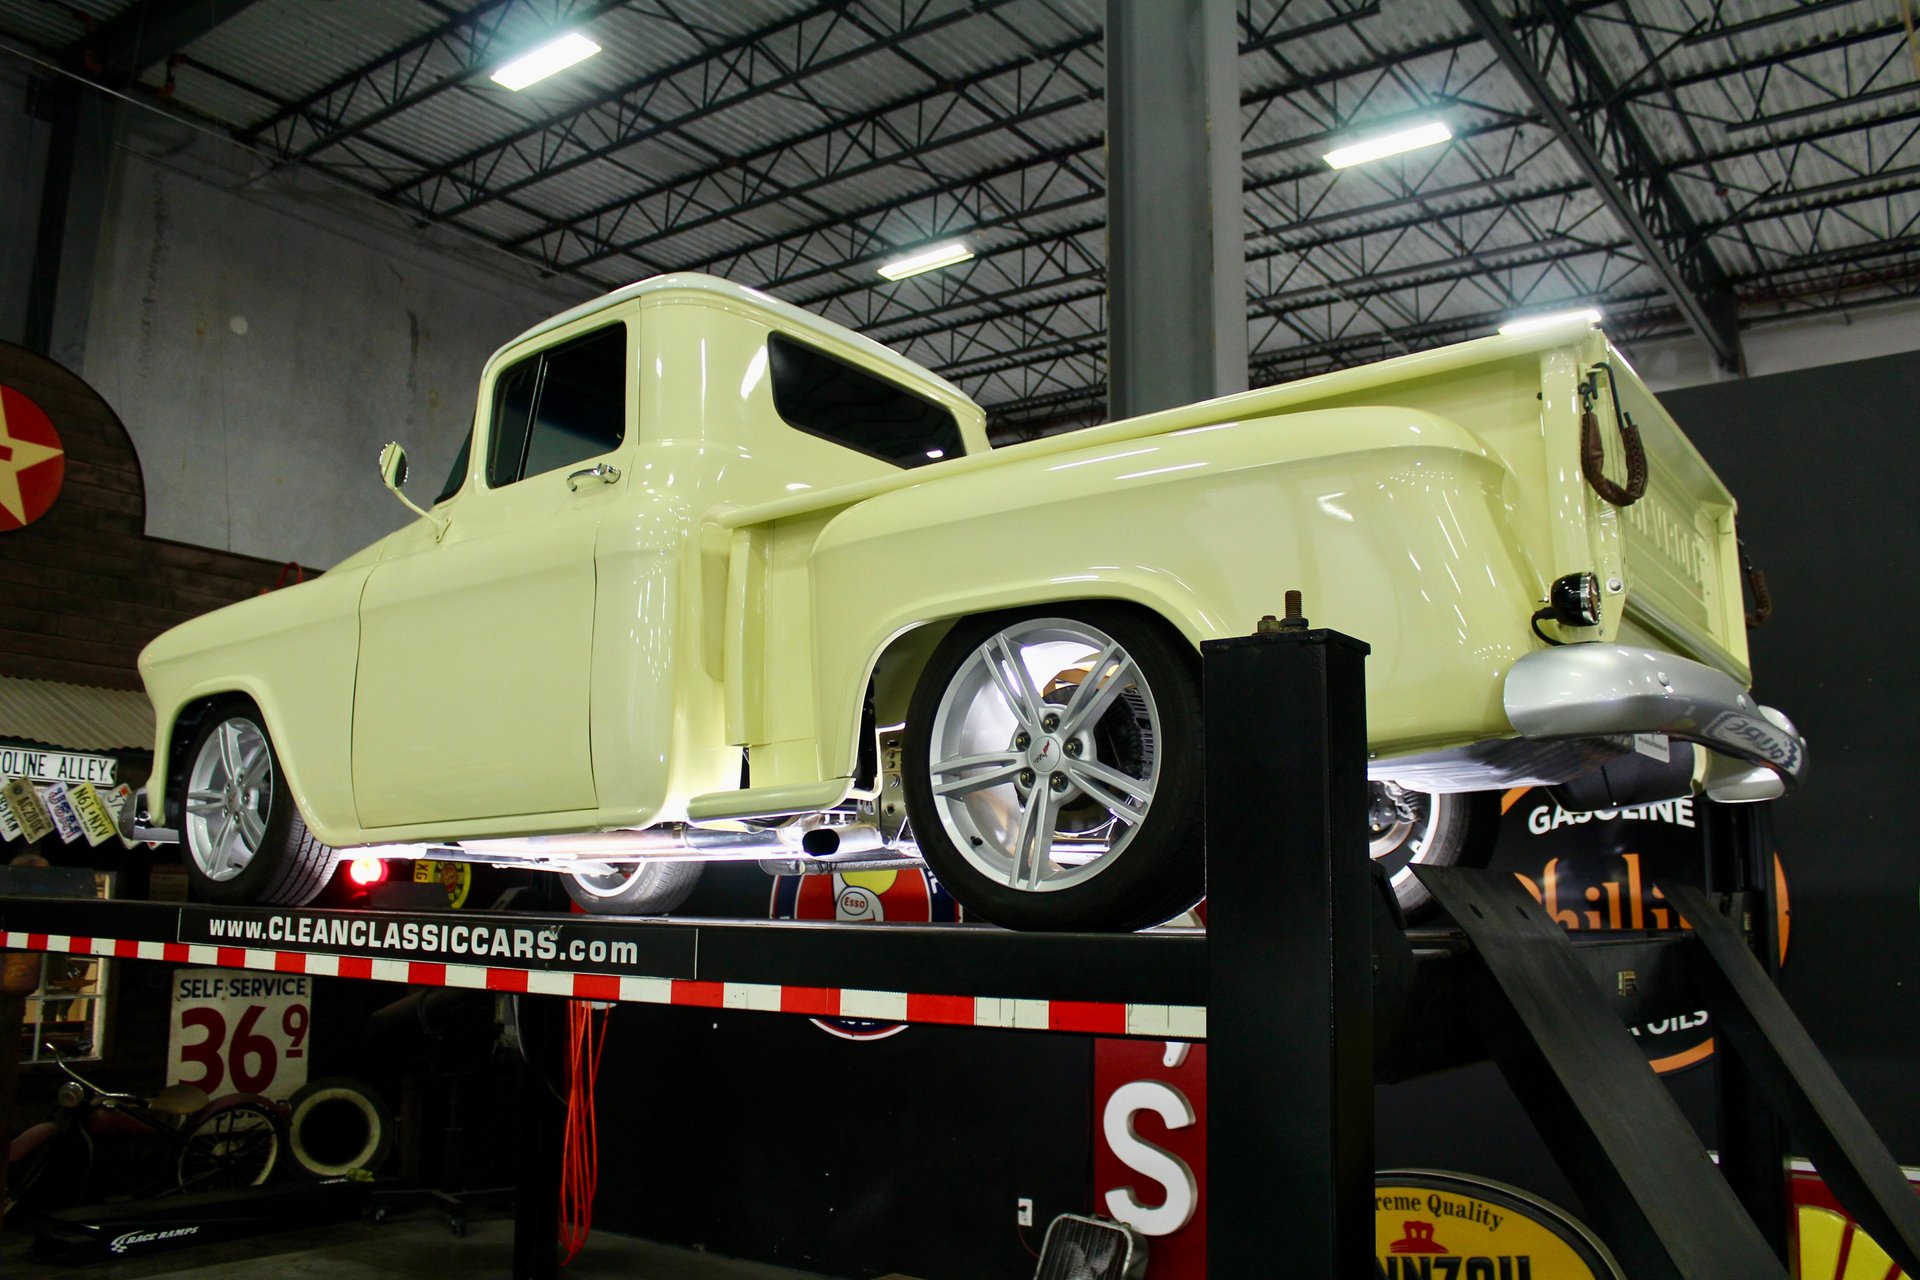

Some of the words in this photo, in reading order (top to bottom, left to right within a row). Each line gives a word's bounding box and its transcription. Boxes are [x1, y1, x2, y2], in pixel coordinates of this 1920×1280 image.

[0, 751, 47, 776] OLINE
[58, 756, 108, 781] ALLEY
[209, 915, 638, 965] www.CLEANCLASSICCARS.com
[1375, 1195, 1422, 1211] reme
[1427, 1193, 1505, 1232] Quality
